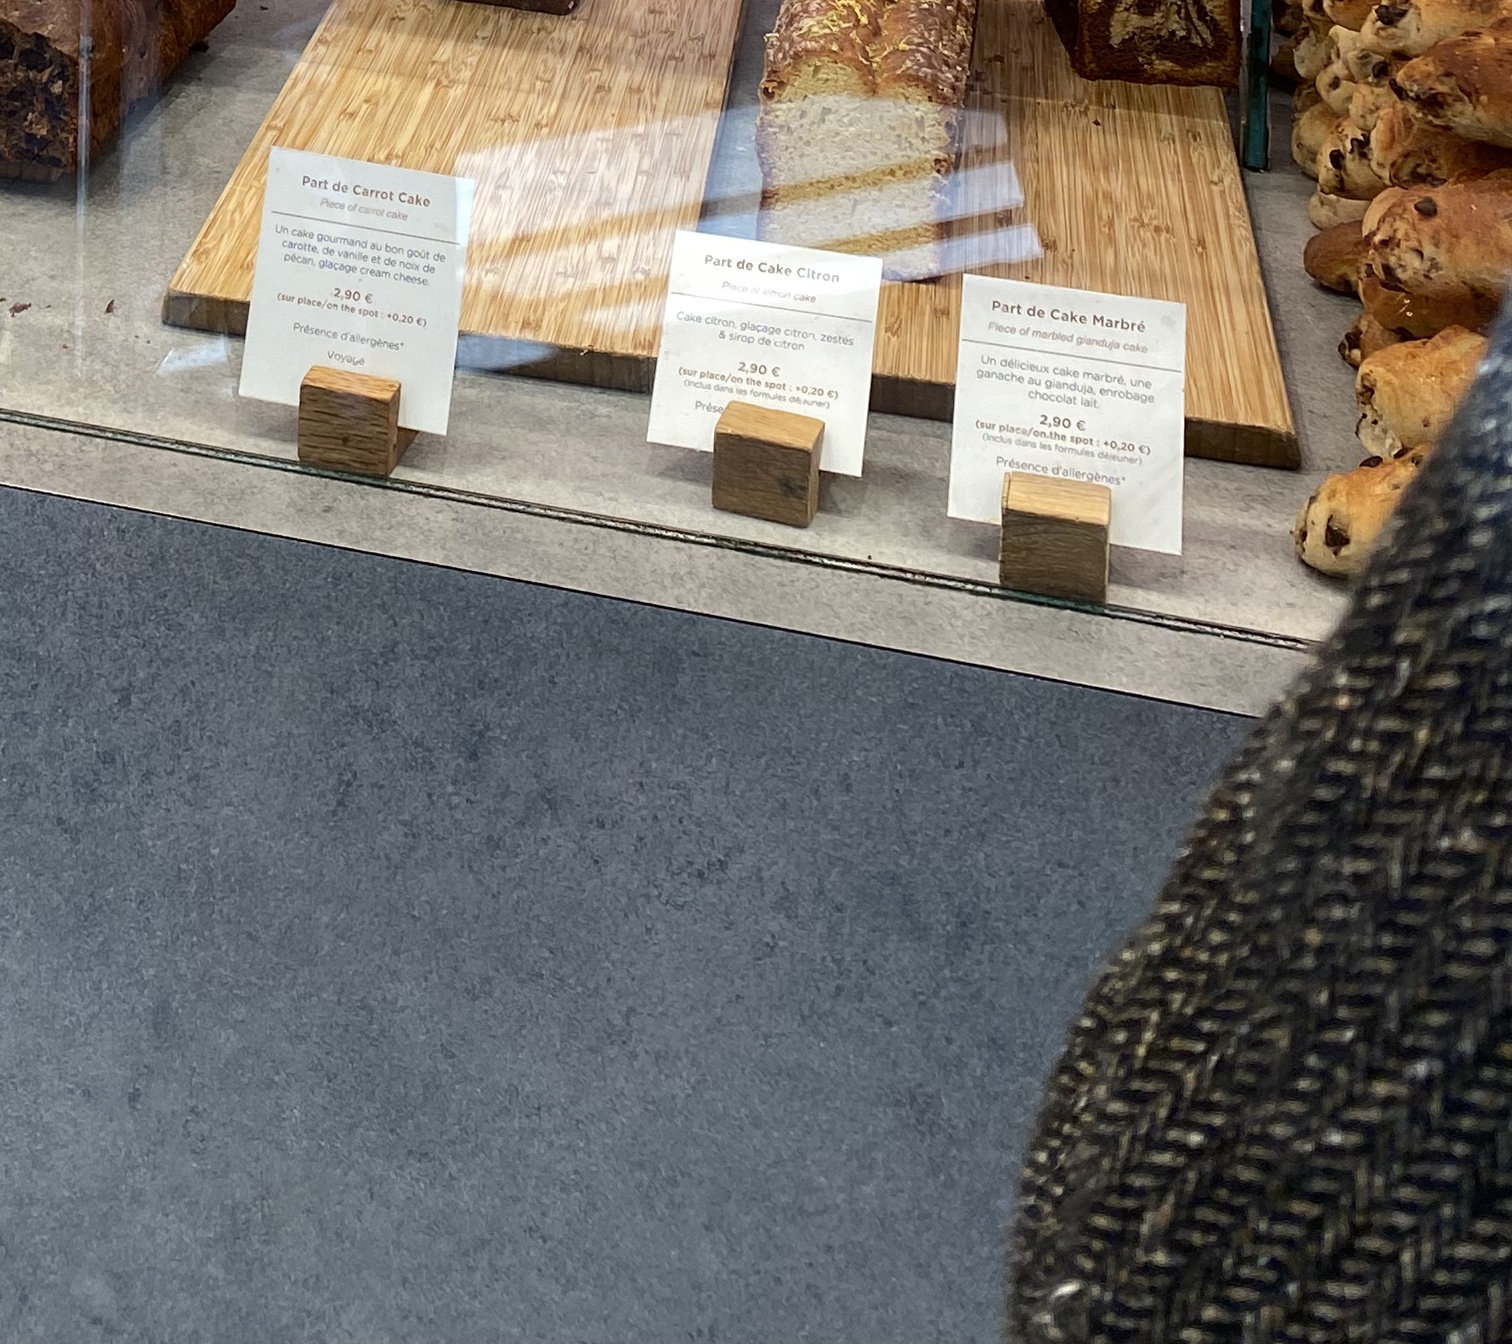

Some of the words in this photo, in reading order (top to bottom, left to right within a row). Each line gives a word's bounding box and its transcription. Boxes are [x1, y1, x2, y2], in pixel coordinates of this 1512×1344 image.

[302, 175, 328, 190] Part
[332, 182, 348, 193] de
[353, 185, 394, 201] Carrot
[398, 192, 430, 207] Cake
[275, 224, 289, 235] Un
[291, 228, 314, 239] cake
[316, 233, 367, 249] gourmand
[370, 242, 382, 251] au
[385, 244, 404, 255] bon
[432, 252, 446, 262] de
[284, 253, 316, 266] pécan,
[319, 259, 358, 275] glaçage
[360, 265, 391, 279] cream
[393, 272, 430, 286] cheese.
[322, 247, 335, 256] de
[337, 248, 368, 262] vanille
[371, 255, 381, 264] et
[383, 257, 397, 267] de
[398, 260, 420, 271] noix
[422, 263, 435, 274] de
[704, 254, 732, 268] Part
[737, 260, 753, 270] de
[758, 262, 792, 276] Cake
[797, 268, 840, 283] Citron
[333, 288, 361, 301] 2,90
[365, 293, 373, 304] €
[676, 311, 702, 323] Cake
[705, 315, 737, 329] citron,
[740, 321, 781, 335] glaçage
[820, 333, 854, 346] zestes
[992, 300, 1022, 315] Part
[1027, 305, 1045, 318] de
[1050, 309, 1087, 324] Cake
[1093, 315, 1145, 332] Marbré
[293, 322, 337, 339] Présence
[719, 331, 726, 339] &
[729, 332, 754, 344] sirop
[757, 337, 771, 346] de
[774, 340, 805, 351] citron
[988, 322, 1016, 334] Piece
[1019, 328, 1030, 336] of
[1032, 329, 1074, 342] marbled
[1076, 335, 1120, 351] gianduja
[1123, 343, 1148, 353] cake
[327, 351, 365, 366] Voyage
[738, 362, 767, 375] 2,90
[771, 366, 780, 377] €
[981, 355, 996, 365] Un
[1000, 359, 1049, 374] délicieux
[1052, 367, 1079, 379] cake
[1083, 371, 1126, 385] marbré,
[1130, 379, 1152, 389] une
[976, 368, 1025, 384] ganache
[1027, 377, 1041, 386] au
[1045, 379, 1096, 395] gianduja,
[1100, 388, 1155, 404] enrobage
[1028, 390, 1077, 405] chocolat
[1080, 396, 1100, 409] lait.
[1040, 414, 1071, 429] 2,90
[1076, 420, 1086, 431] €
[996, 456, 1048, 474] Présence
